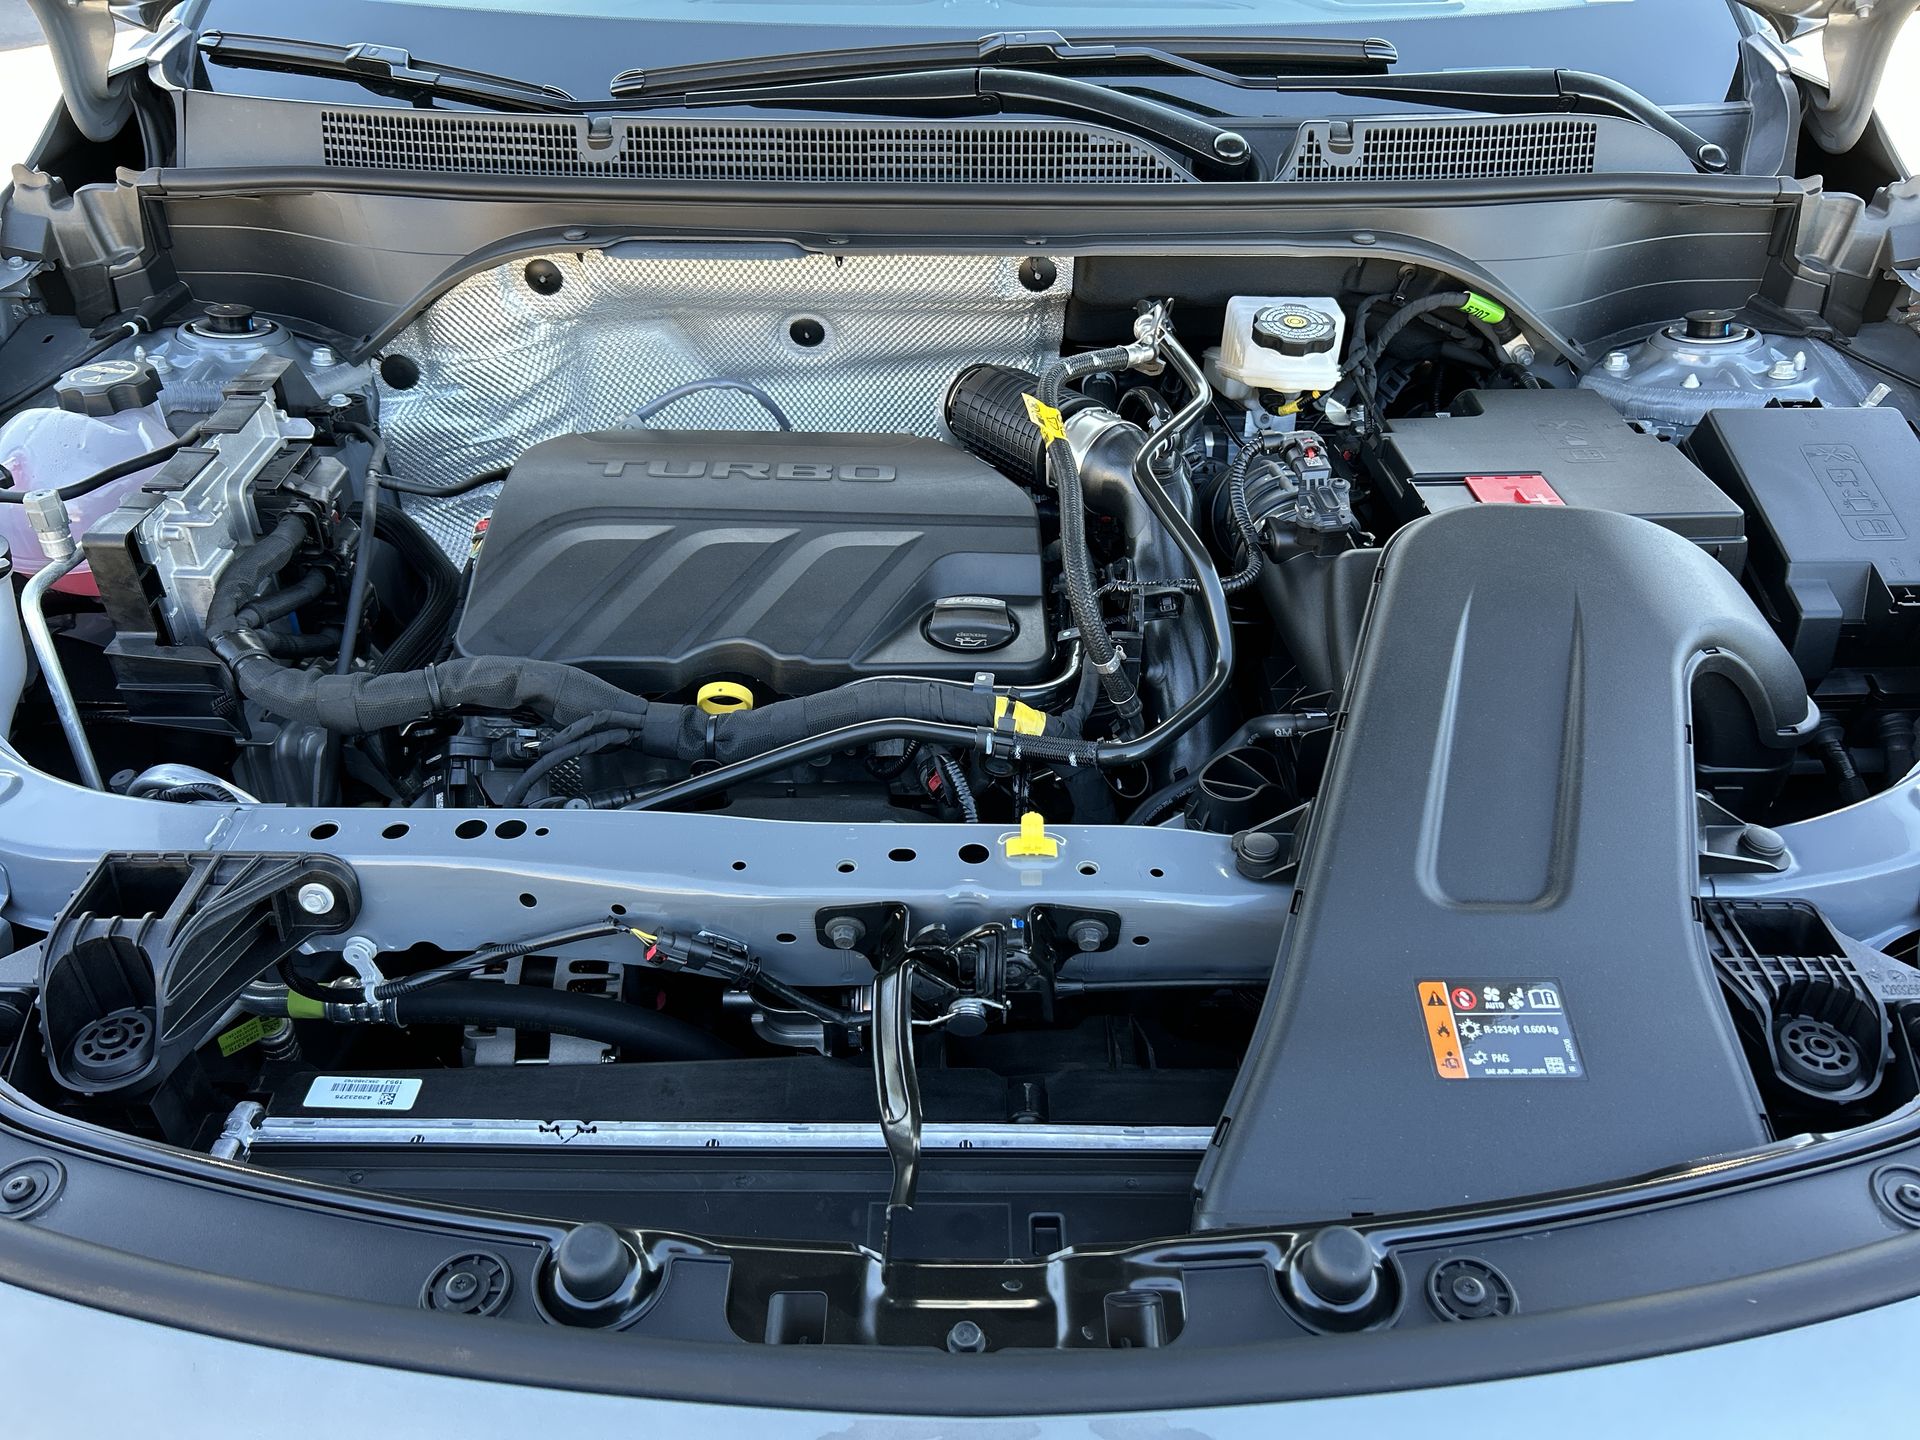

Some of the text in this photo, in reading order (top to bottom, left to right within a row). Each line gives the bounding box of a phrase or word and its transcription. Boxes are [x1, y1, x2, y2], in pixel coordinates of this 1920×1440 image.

[587, 459, 897, 482] TURBO
[1485, 1001, 1505, 1010] AUTO
[1483, 1025, 1520, 1036] R-1234yf
[1547, 1025, 1560, 1035] kg
[1491, 1053, 1511, 1063] PAG
